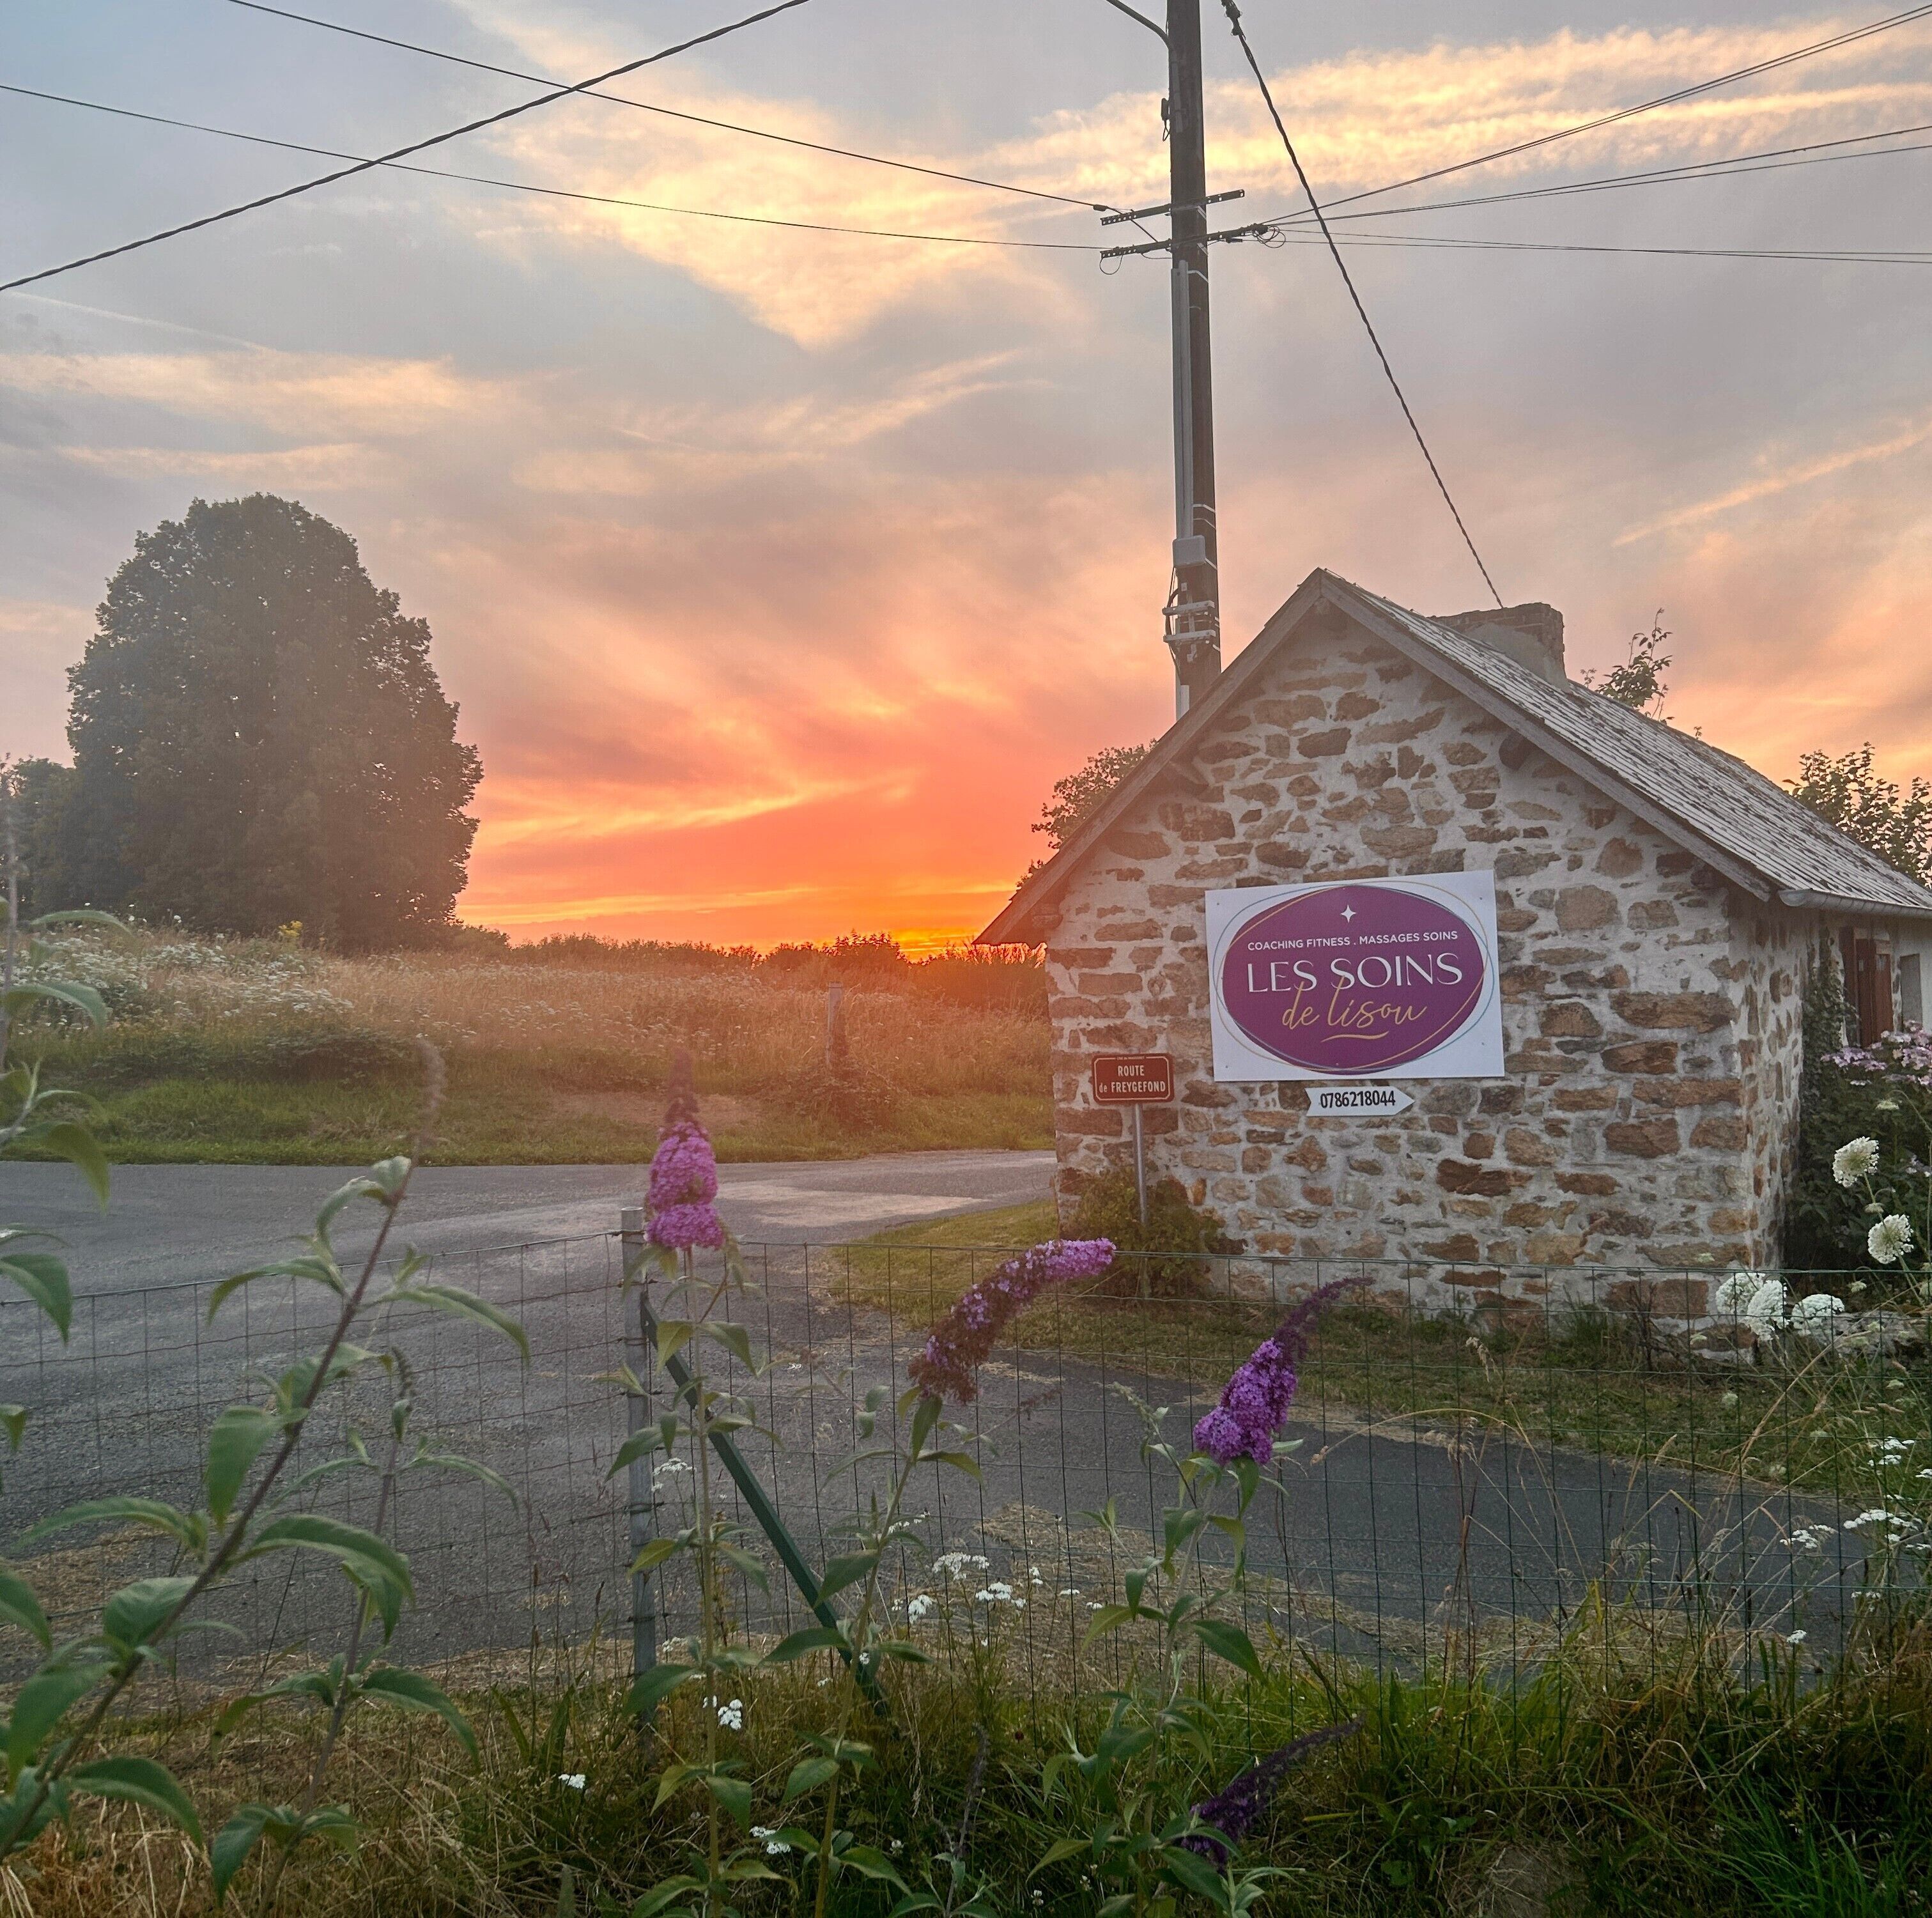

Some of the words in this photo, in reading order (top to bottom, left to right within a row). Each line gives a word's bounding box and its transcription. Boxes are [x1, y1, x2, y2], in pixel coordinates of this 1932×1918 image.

[1248, 938, 1303, 951] COACHING
[1306, 936, 1350, 948] FITNESS
[1359, 932, 1420, 945] MASSAGES
[1423, 931, 1458, 941] SOINS
[1248, 960, 1317, 993] LES
[1330, 952, 1463, 989] SOINS
[1282, 981, 1319, 1029] de
[1327, 976, 1427, 1028] lisou
[1117, 1065, 1145, 1077] ROUTE
[1099, 1082, 1108, 1093] de
[1111, 1081, 1166, 1093] FREYGEFOND
[1320, 1090, 1396, 1108] 0786218044
